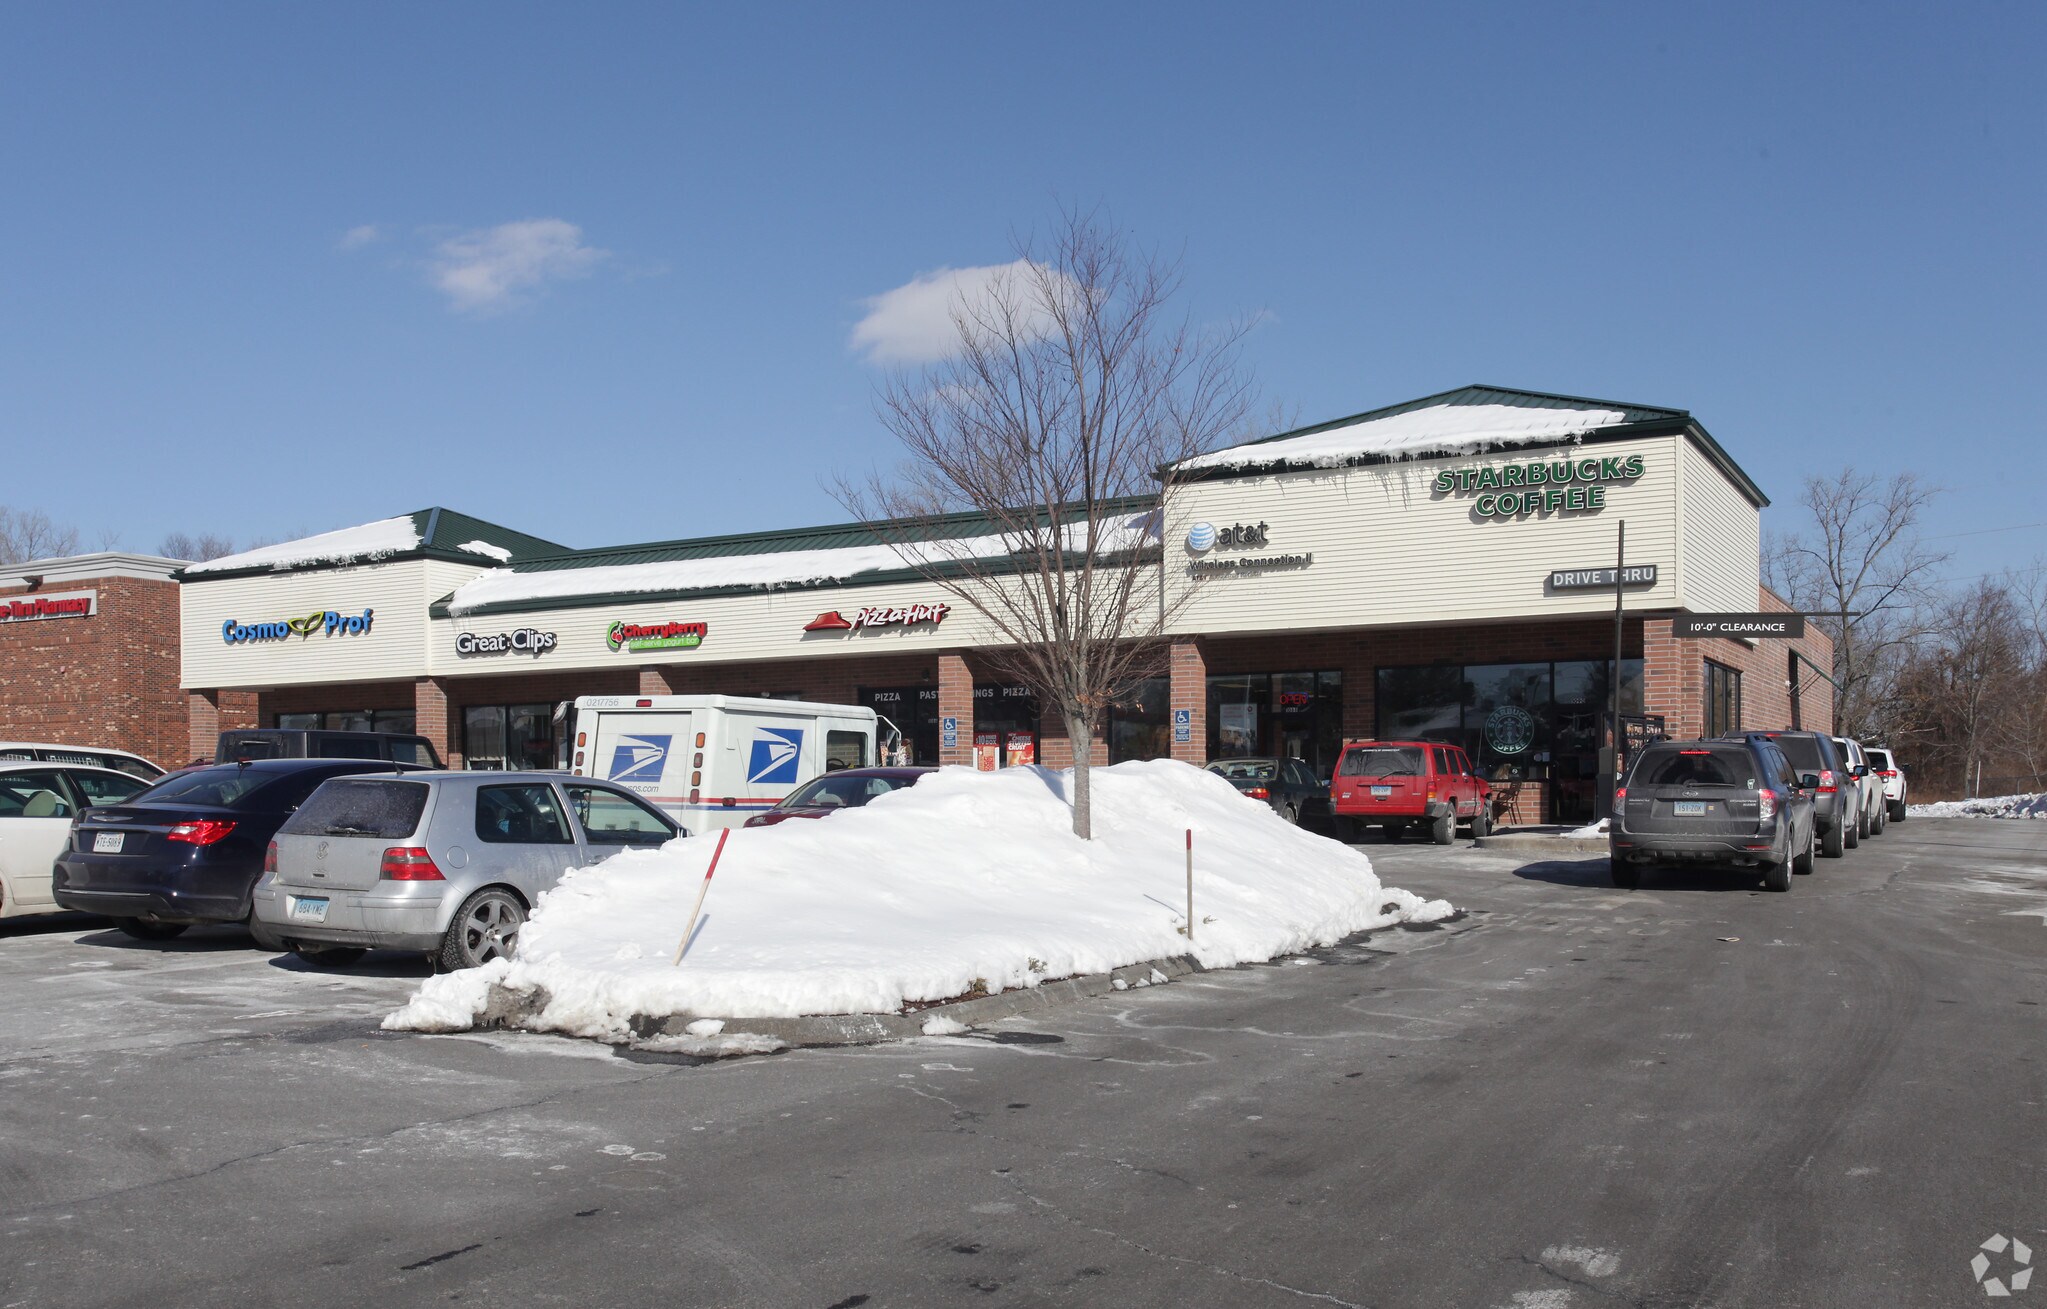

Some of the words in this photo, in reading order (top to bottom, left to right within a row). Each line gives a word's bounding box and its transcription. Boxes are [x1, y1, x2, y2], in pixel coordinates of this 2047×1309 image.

[1436, 454, 1645, 492] STARBUCKS
[1475, 485, 1606, 517] COFFEE
[1219, 520, 1268, 545] at&t
[1189, 559, 1235, 570] Wireless
[1239, 554, 1302, 567] Connection
[1553, 571, 1601, 586] DRIVE
[1608, 567, 1654, 582] THRU
[35, 598, 88, 615] Pharmacy
[222, 619, 289, 641] Cosmo
[324, 608, 373, 634] Prof
[852, 607, 904, 629] Pizza
[902, 603, 949, 626] Hut
[623, 621, 706, 638] CherryBerry
[1690, 622, 1717, 632] 10'-0"
[1719, 622, 1786, 632] CLEARANCE
[456, 632, 508, 654] Great
[511, 628, 556, 654] Clips
[586, 698, 620, 707] 0217756
[875, 692, 901, 702] PIZZA
[972, 688, 994, 698] INGS
[1002, 687, 1031, 697] PIZZA
[1280, 693, 1308, 705] OPEN
[1488, 708, 1532, 729] STARBUCKS
[1493, 740, 1527, 752] COFFEE
[624, 785, 660, 794] sps.com
